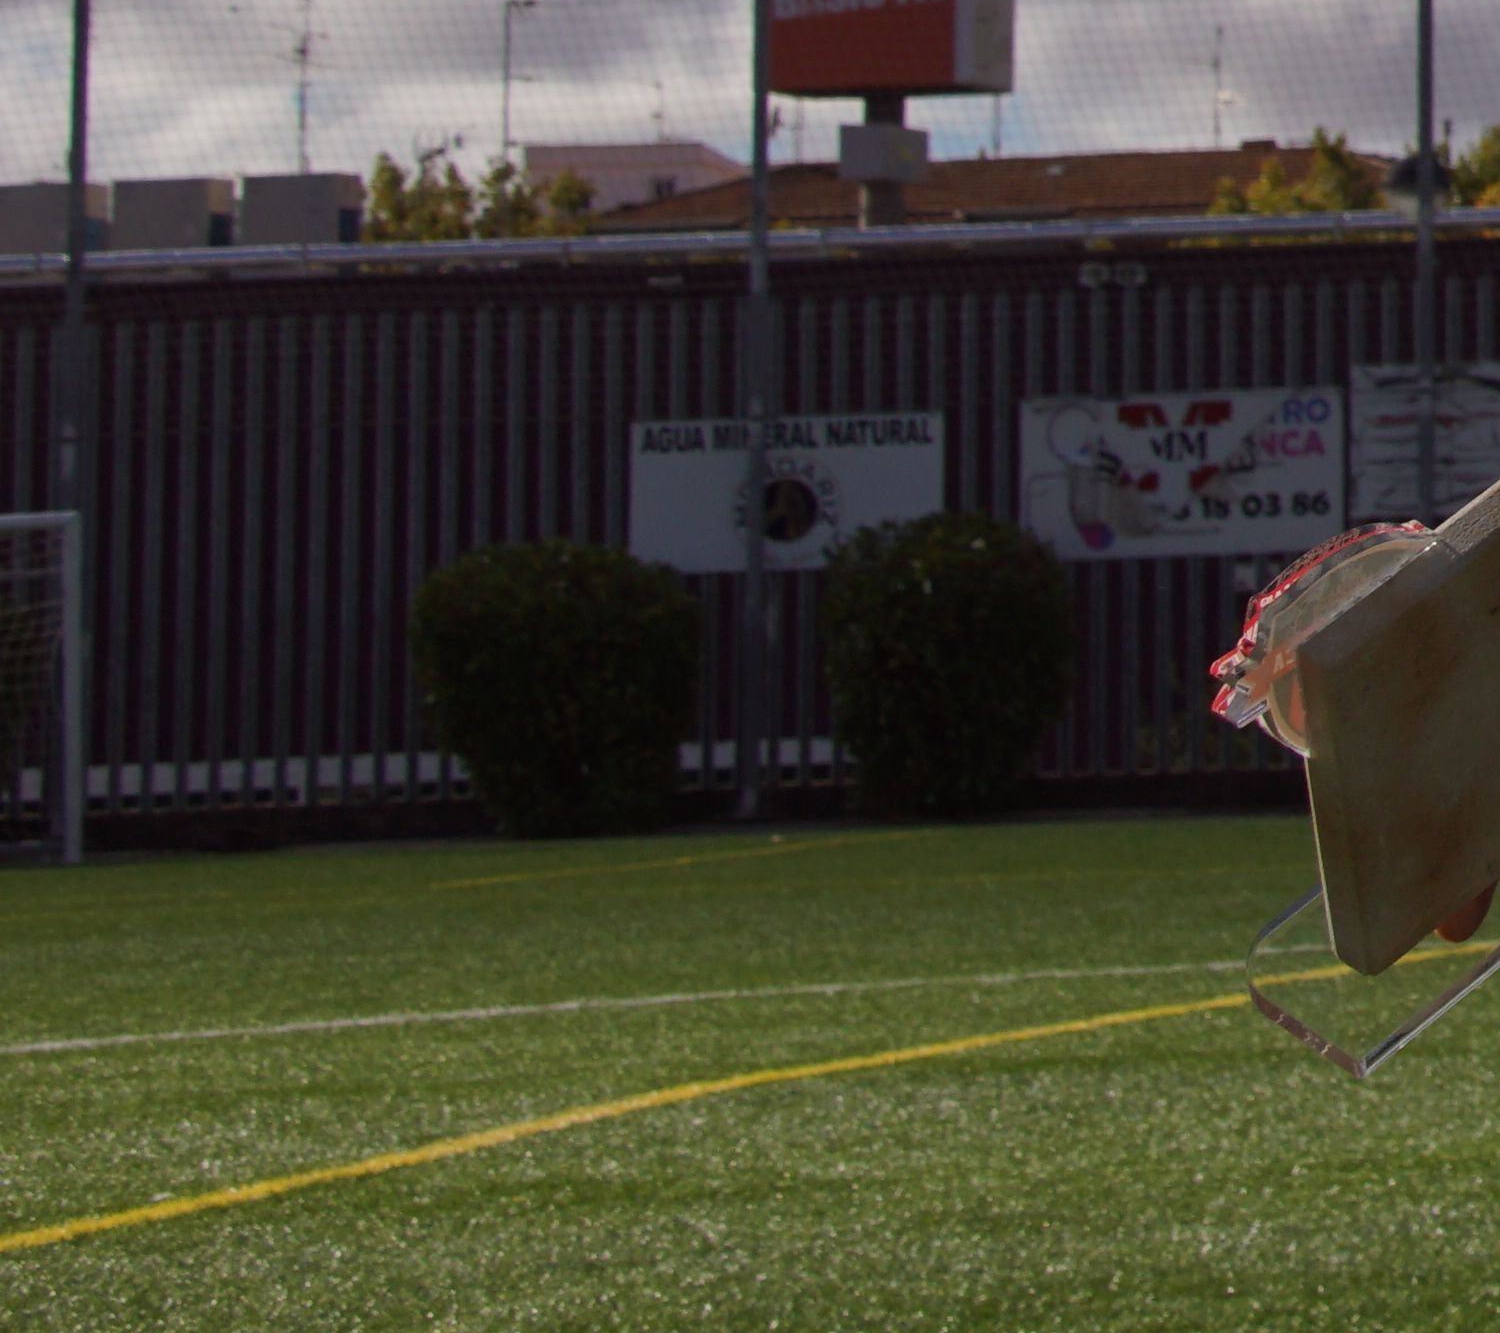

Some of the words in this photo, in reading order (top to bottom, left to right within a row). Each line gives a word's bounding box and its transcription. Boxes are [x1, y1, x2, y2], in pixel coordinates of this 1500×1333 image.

[640, 426, 706, 453] AGUA
[825, 418, 935, 448] NATURAL
[1242, 493, 1281, 518] 03
